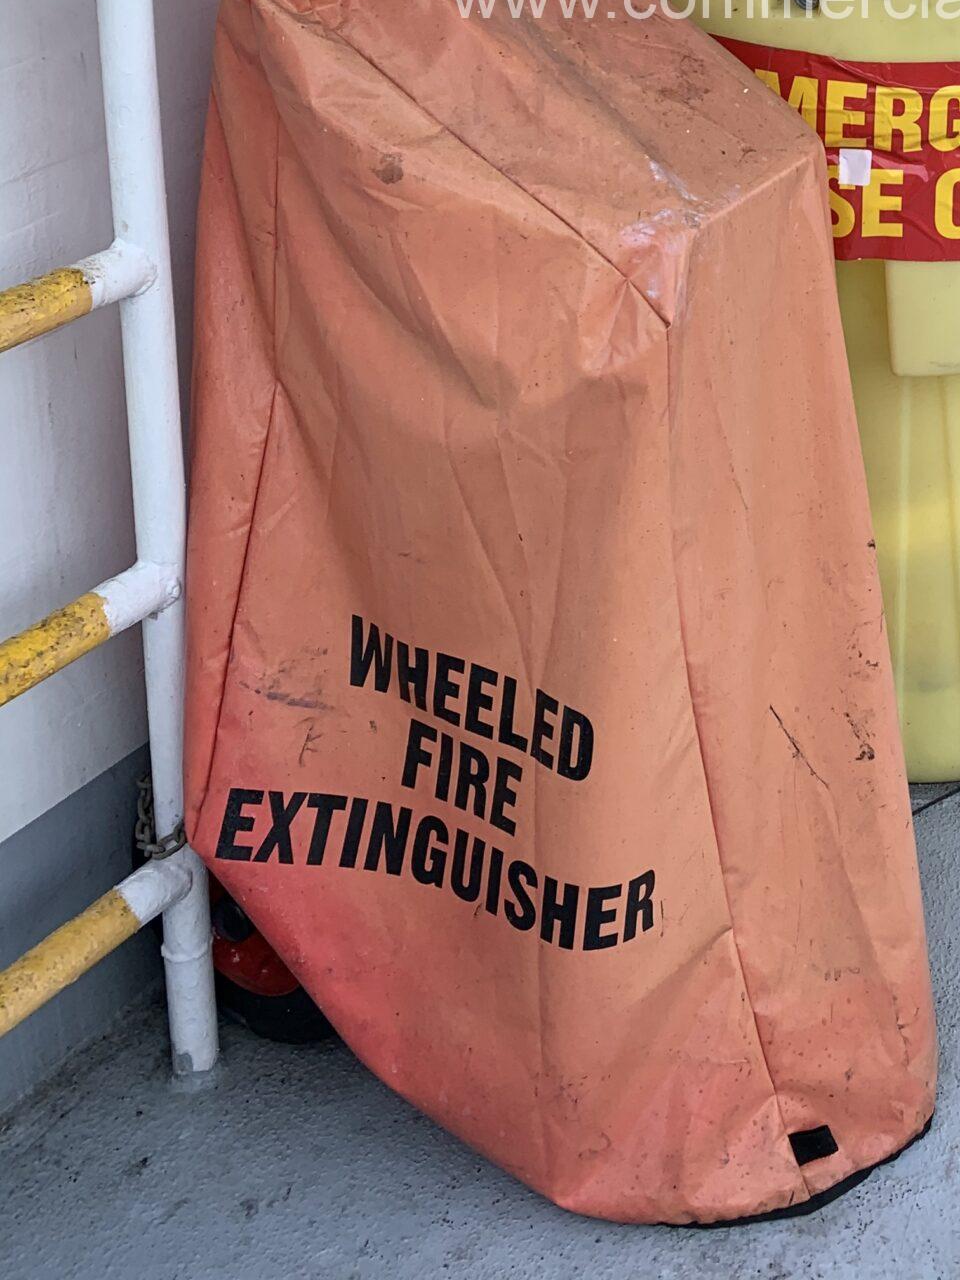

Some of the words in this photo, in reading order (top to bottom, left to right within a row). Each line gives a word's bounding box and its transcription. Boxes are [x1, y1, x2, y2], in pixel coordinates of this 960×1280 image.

[350, 614, 594, 781] WHEELED
[401, 719, 523, 837] FIRE
[215, 788, 656, 951] EXTINGUISHER
